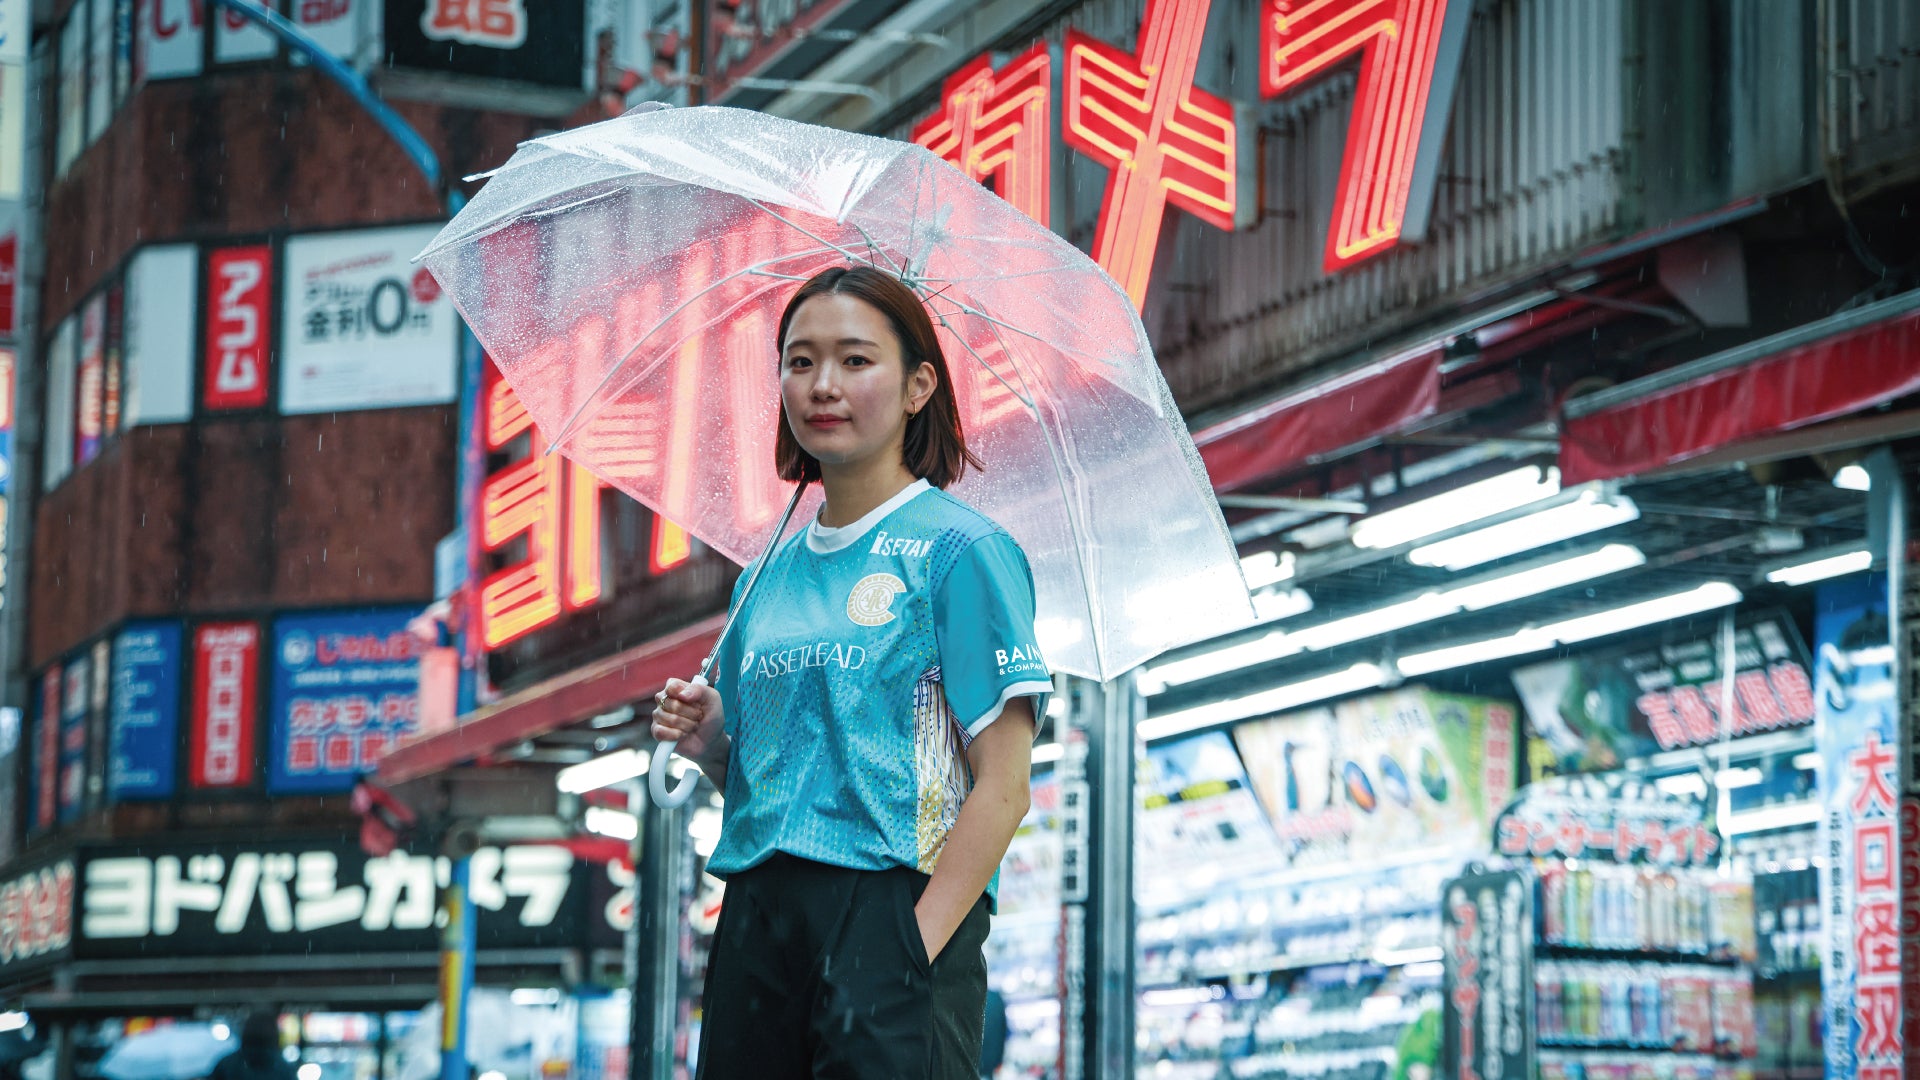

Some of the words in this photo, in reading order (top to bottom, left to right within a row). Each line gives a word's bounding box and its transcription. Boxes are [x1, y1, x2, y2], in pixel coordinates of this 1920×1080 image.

[216, 260, 262, 393] アコム
[755, 642, 866, 681] ASSETLEAD
[999, 668, 1006, 676] &
[1849, 735, 1900, 1080] 大口径双
